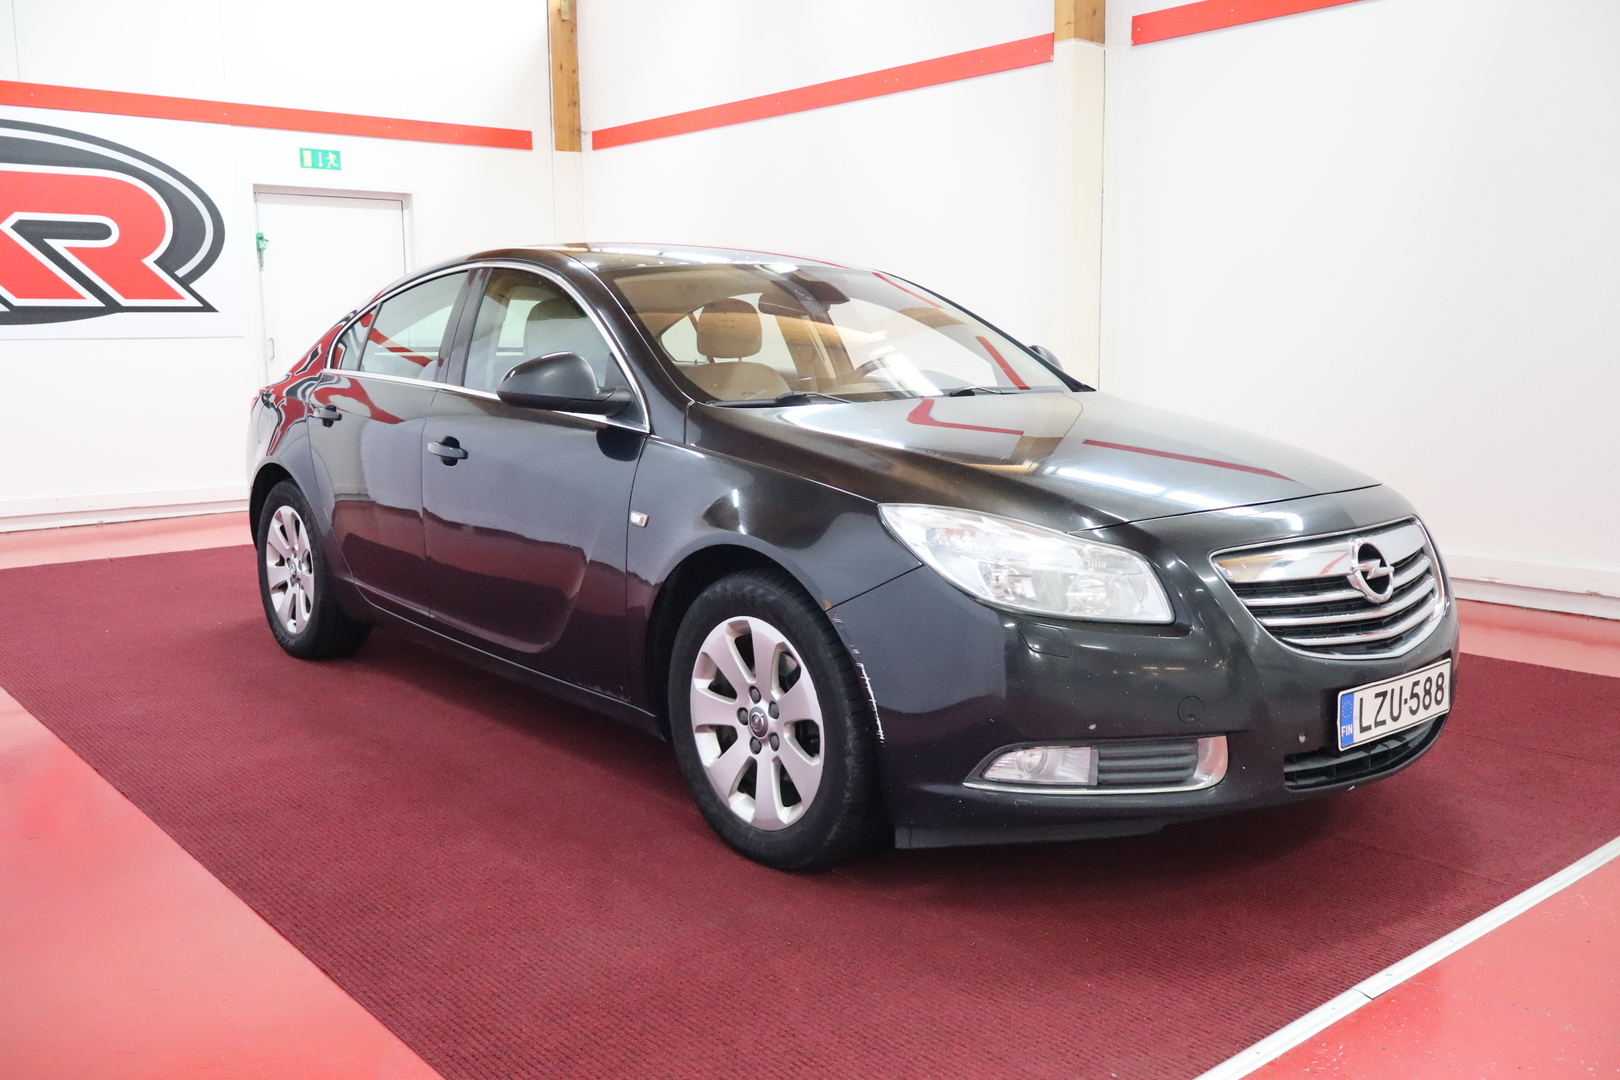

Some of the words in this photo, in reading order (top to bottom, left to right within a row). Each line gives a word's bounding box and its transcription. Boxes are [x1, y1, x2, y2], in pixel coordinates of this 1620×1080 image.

[0, 166, 200, 305] R
[1341, 723, 1353, 738] FIN
[1359, 672, 1445, 734] LZU-588
